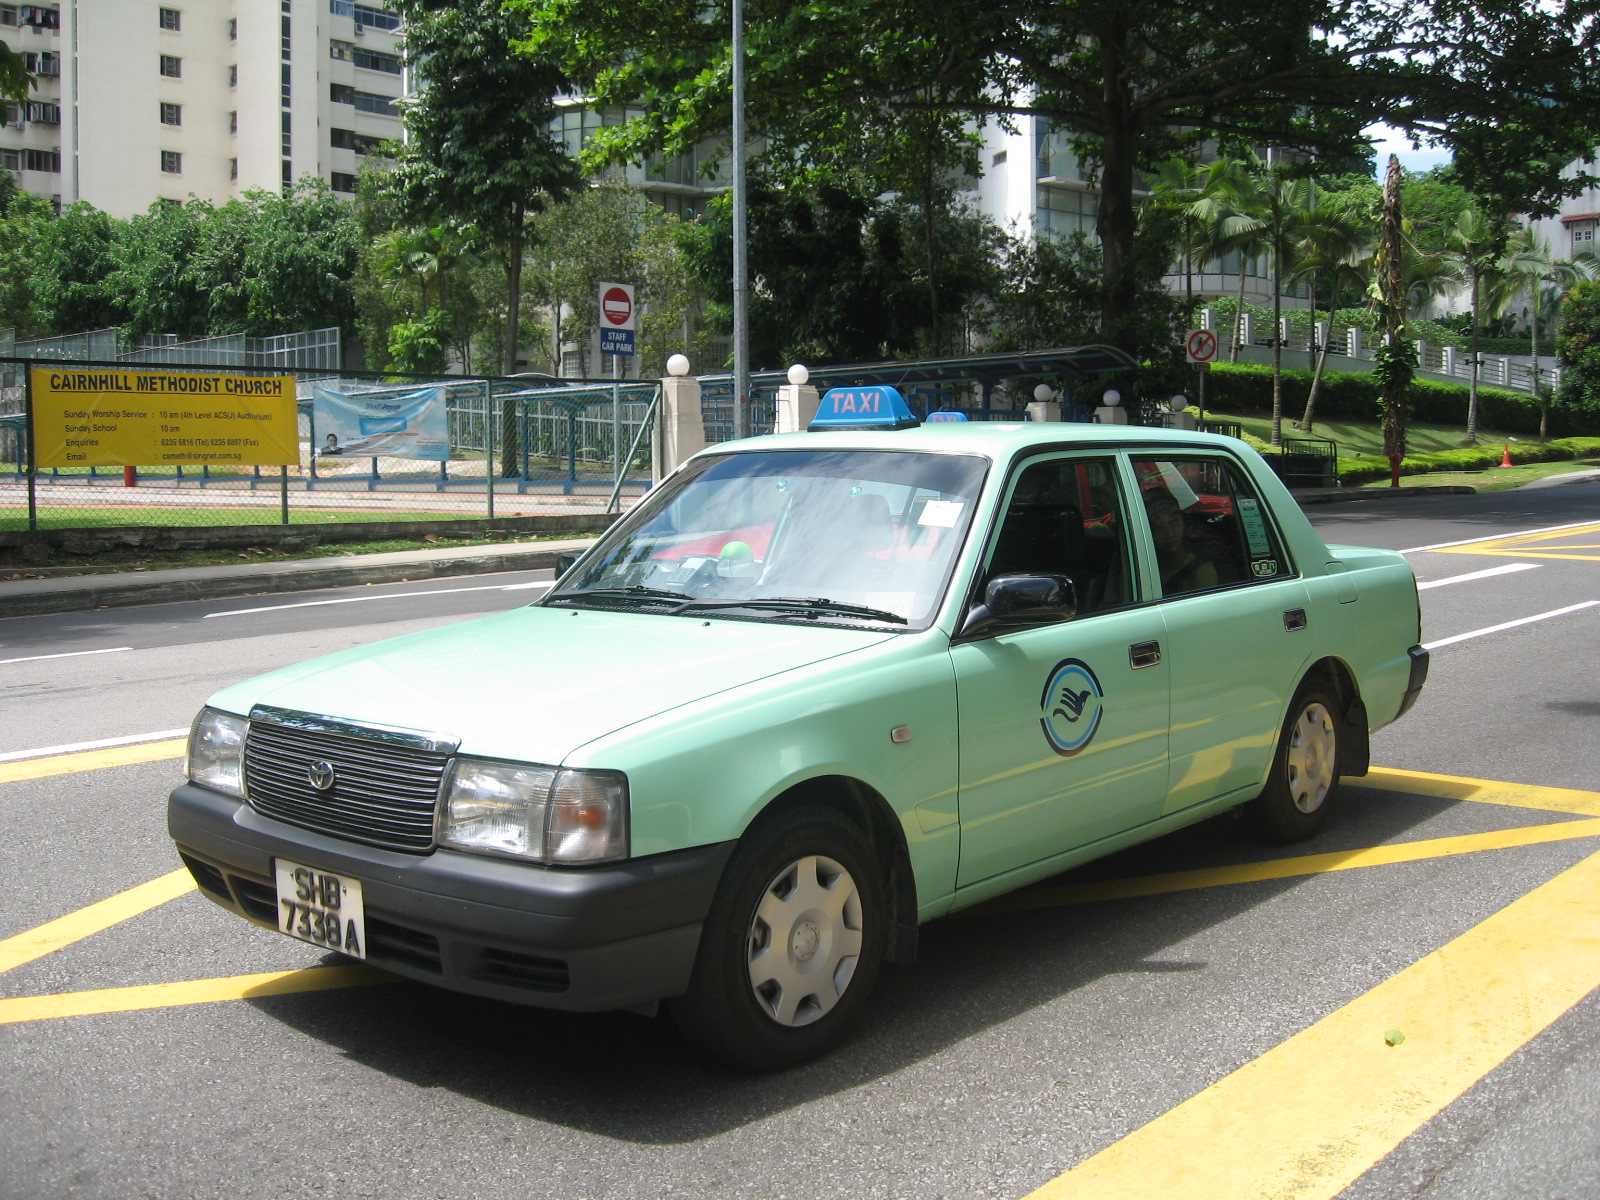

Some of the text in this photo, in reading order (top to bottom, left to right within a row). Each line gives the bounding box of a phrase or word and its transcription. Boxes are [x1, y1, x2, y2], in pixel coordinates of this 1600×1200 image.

[608, 332, 626, 341] STAFF
[602, 341, 633, 352] CAR PARK
[50, 374, 282, 394] CAIRNHILL METHODIST CHURCH
[830, 392, 881, 414] TAXI
[64, 411, 91, 419] Sunday
[92, 410, 120, 418] Worship
[122, 410, 147, 418] Service
[160, 411, 168, 419] 10
[180, 411, 193, 420] (4th
[194, 411, 212, 419] Level
[214, 412, 236, 420] ACS(J)
[237, 412, 273, 421] Auditorium)
[65, 425, 91, 433] Sunday
[66, 439, 99, 447] Enquiries
[195, 439, 209, 447] (Tel)
[243, 439, 259, 447] (Fax)
[66, 453, 87, 461] Email
[162, 452, 242, 461] cameth@singnet.com.sg
[294, 867, 341, 910] SHB
[281, 897, 361, 953] 7338A
